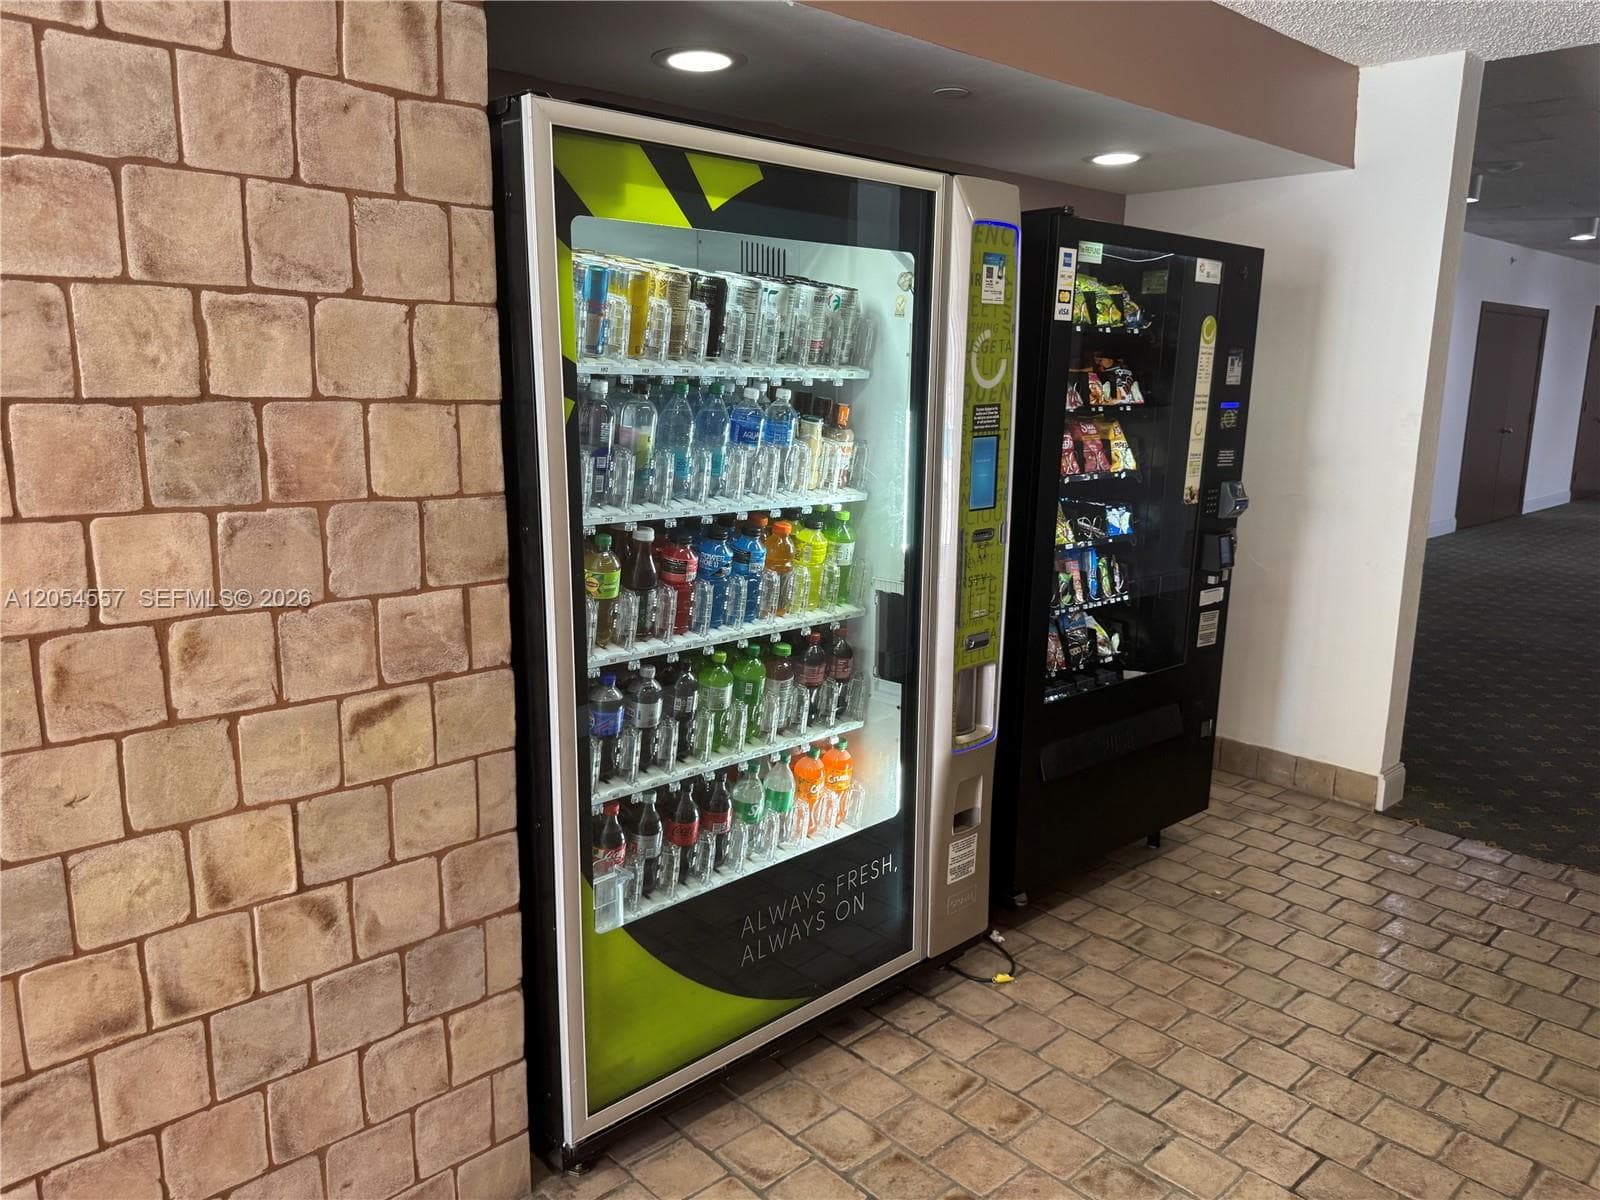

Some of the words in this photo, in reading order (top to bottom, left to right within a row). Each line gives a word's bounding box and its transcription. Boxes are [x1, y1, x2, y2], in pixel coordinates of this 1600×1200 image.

[741, 883, 826, 939] ALWAYS
[836, 853, 898, 896] FRESH,
[741, 911, 826, 967] ALWAYS
[835, 892, 865, 921] ON
